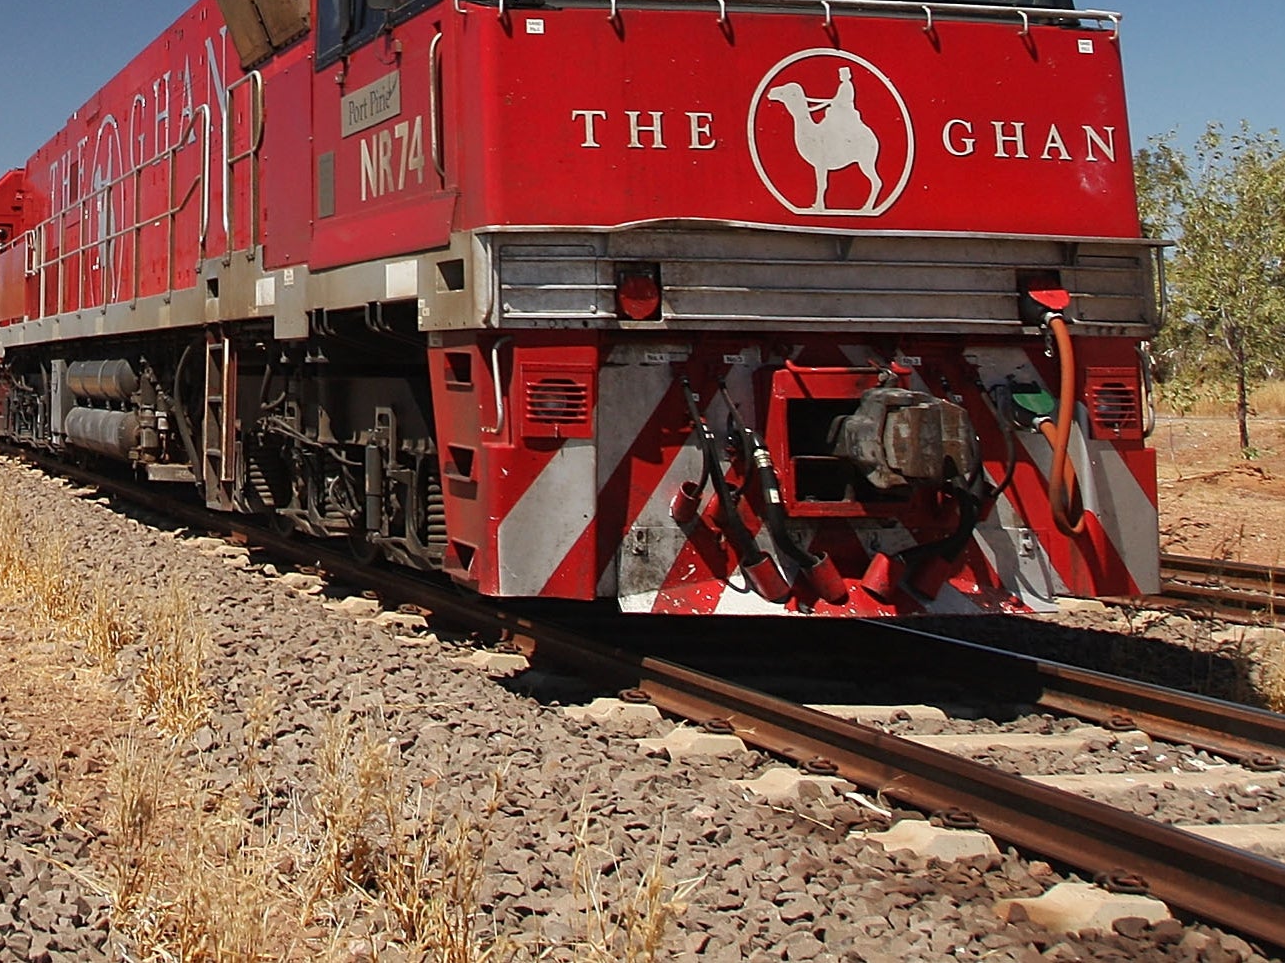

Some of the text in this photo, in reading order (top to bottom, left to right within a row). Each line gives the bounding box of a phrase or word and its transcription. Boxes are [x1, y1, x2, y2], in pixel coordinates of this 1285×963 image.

[130, 25, 227, 172] GHAN
[348, 98, 368, 126] Port
[360, 115, 425, 201] NR74
[571, 109, 1116, 162] THE GHAN
